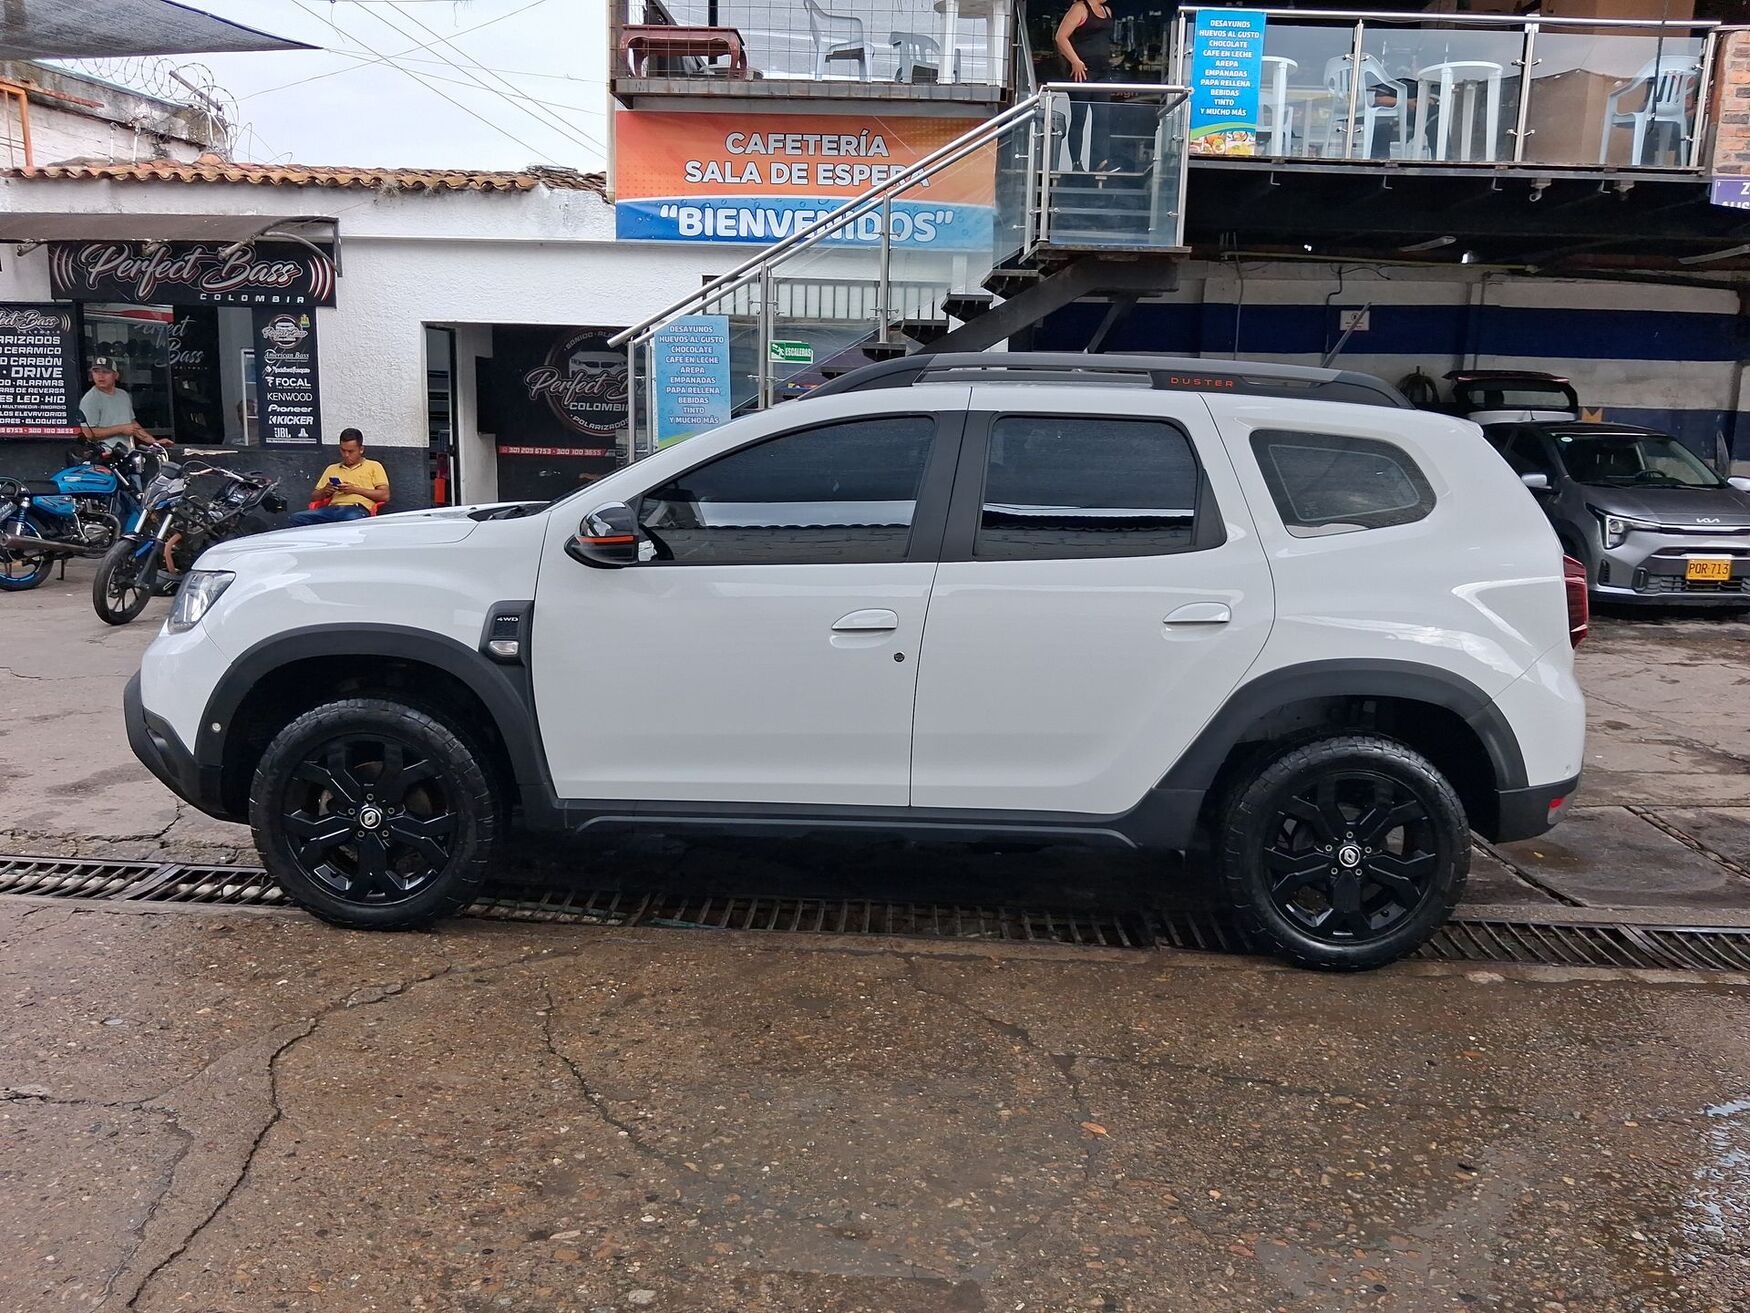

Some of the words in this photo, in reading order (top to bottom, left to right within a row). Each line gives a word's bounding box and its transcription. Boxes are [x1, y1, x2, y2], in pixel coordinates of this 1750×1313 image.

[1210, 20, 1250, 28] DESAYUNOS
[1232, 108, 1246, 116] MÁS
[725, 129, 889, 157] CAFETERÍA
[684, 160, 763, 184] SALA
[770, 162, 809, 186] DE
[80, 243, 208, 299] Perfect
[201, 246, 298, 290] Bass
[200, 293, 304, 304] COLOMBIA
[17, 310, 59, 330] Bass
[10, 356, 62, 366] CARBÓN
[11, 367, 63, 378] DRIVE
[276, 378, 312, 386] FOCAL
[525, 367, 606, 406] Perfect
[1170, 377, 1234, 388] DUSTER
[17, 395, 40, 403] LED
[45, 396, 66, 404] HID
[267, 392, 312, 401] KENWOOD
[268, 404, 313, 412] Pioneer
[276, 416, 314, 424] KICKER
[704, 415, 719, 423] MÁS
[1711, 563, 1729, 574] 713
